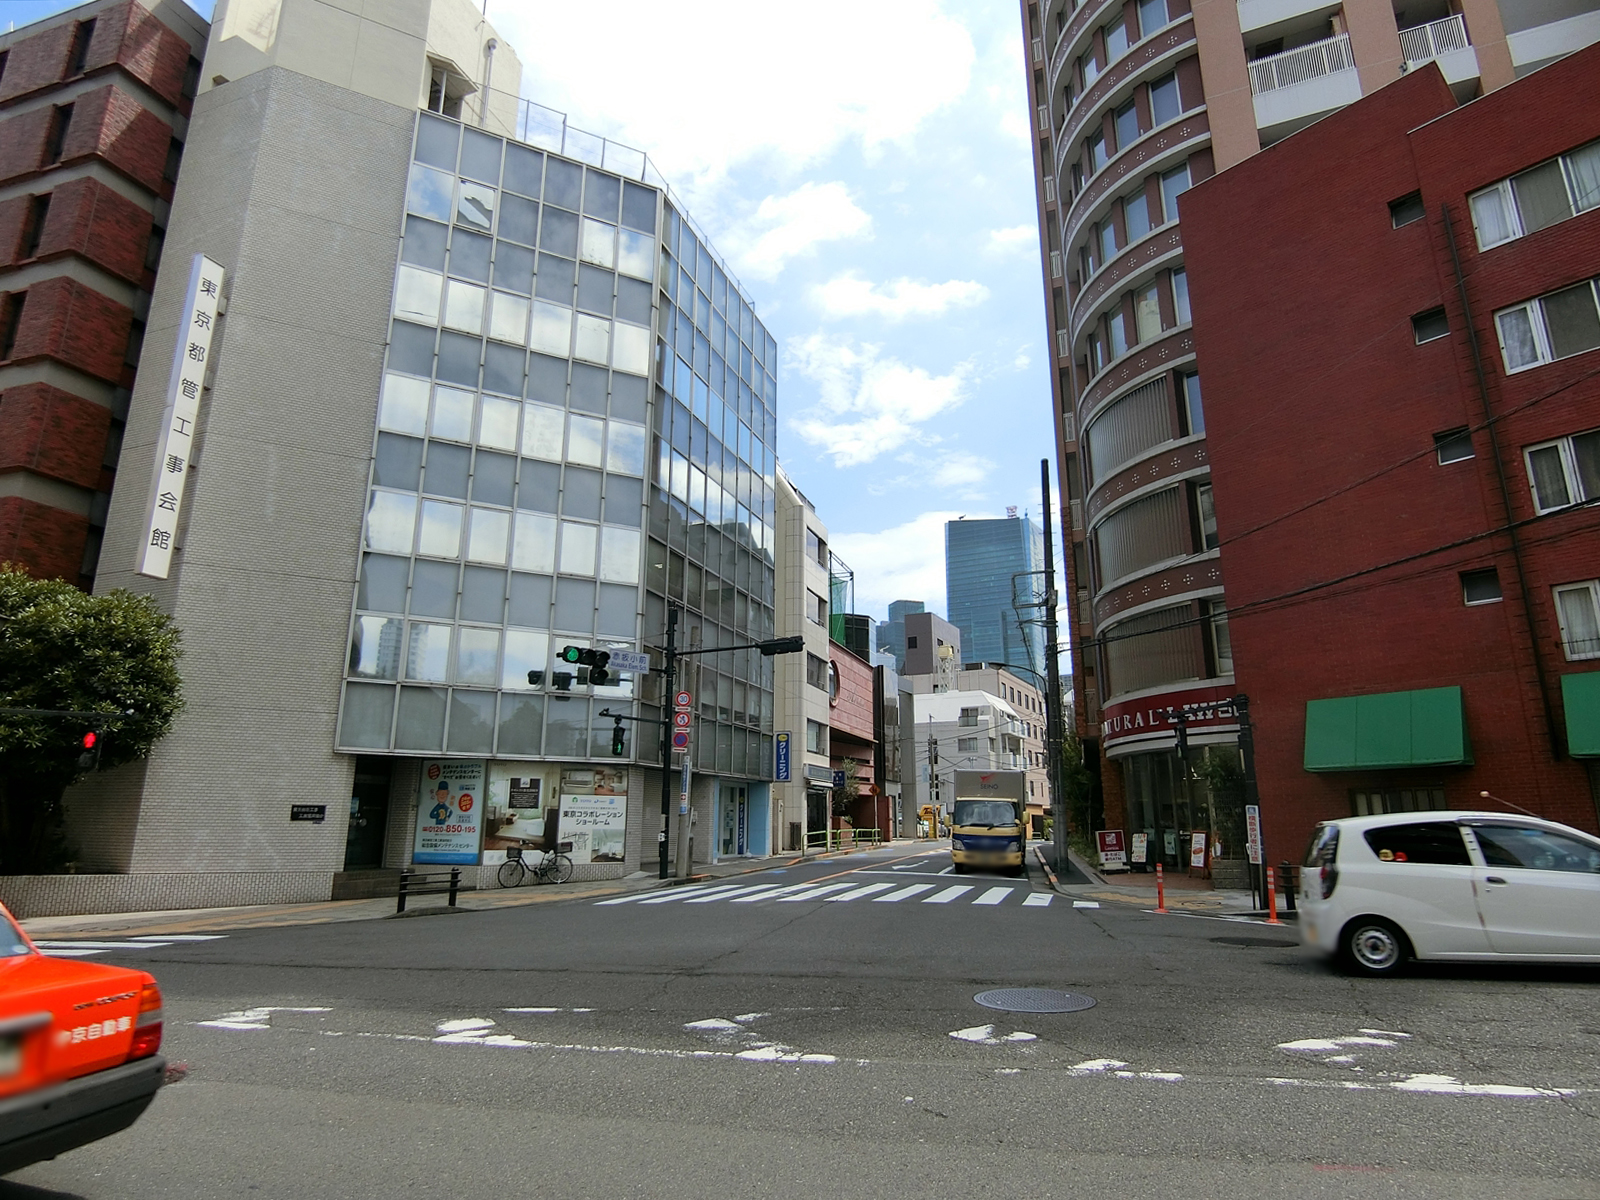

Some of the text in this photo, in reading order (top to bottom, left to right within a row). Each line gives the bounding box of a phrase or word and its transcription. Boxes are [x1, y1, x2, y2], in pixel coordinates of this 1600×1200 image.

[150, 276, 217, 550] 東京都管工事会館
[612, 652, 647, 664] 赤坂小前
[680, 695, 688, 703] 30
[779, 741, 787, 779] クリーニング
[562, 810, 623, 818] 東京コラボレーション
[575, 818, 610, 826] ショールーム
[428, 824, 476, 833] 0120-850-195
[56, 1015, 132, 1045] 京自動車
